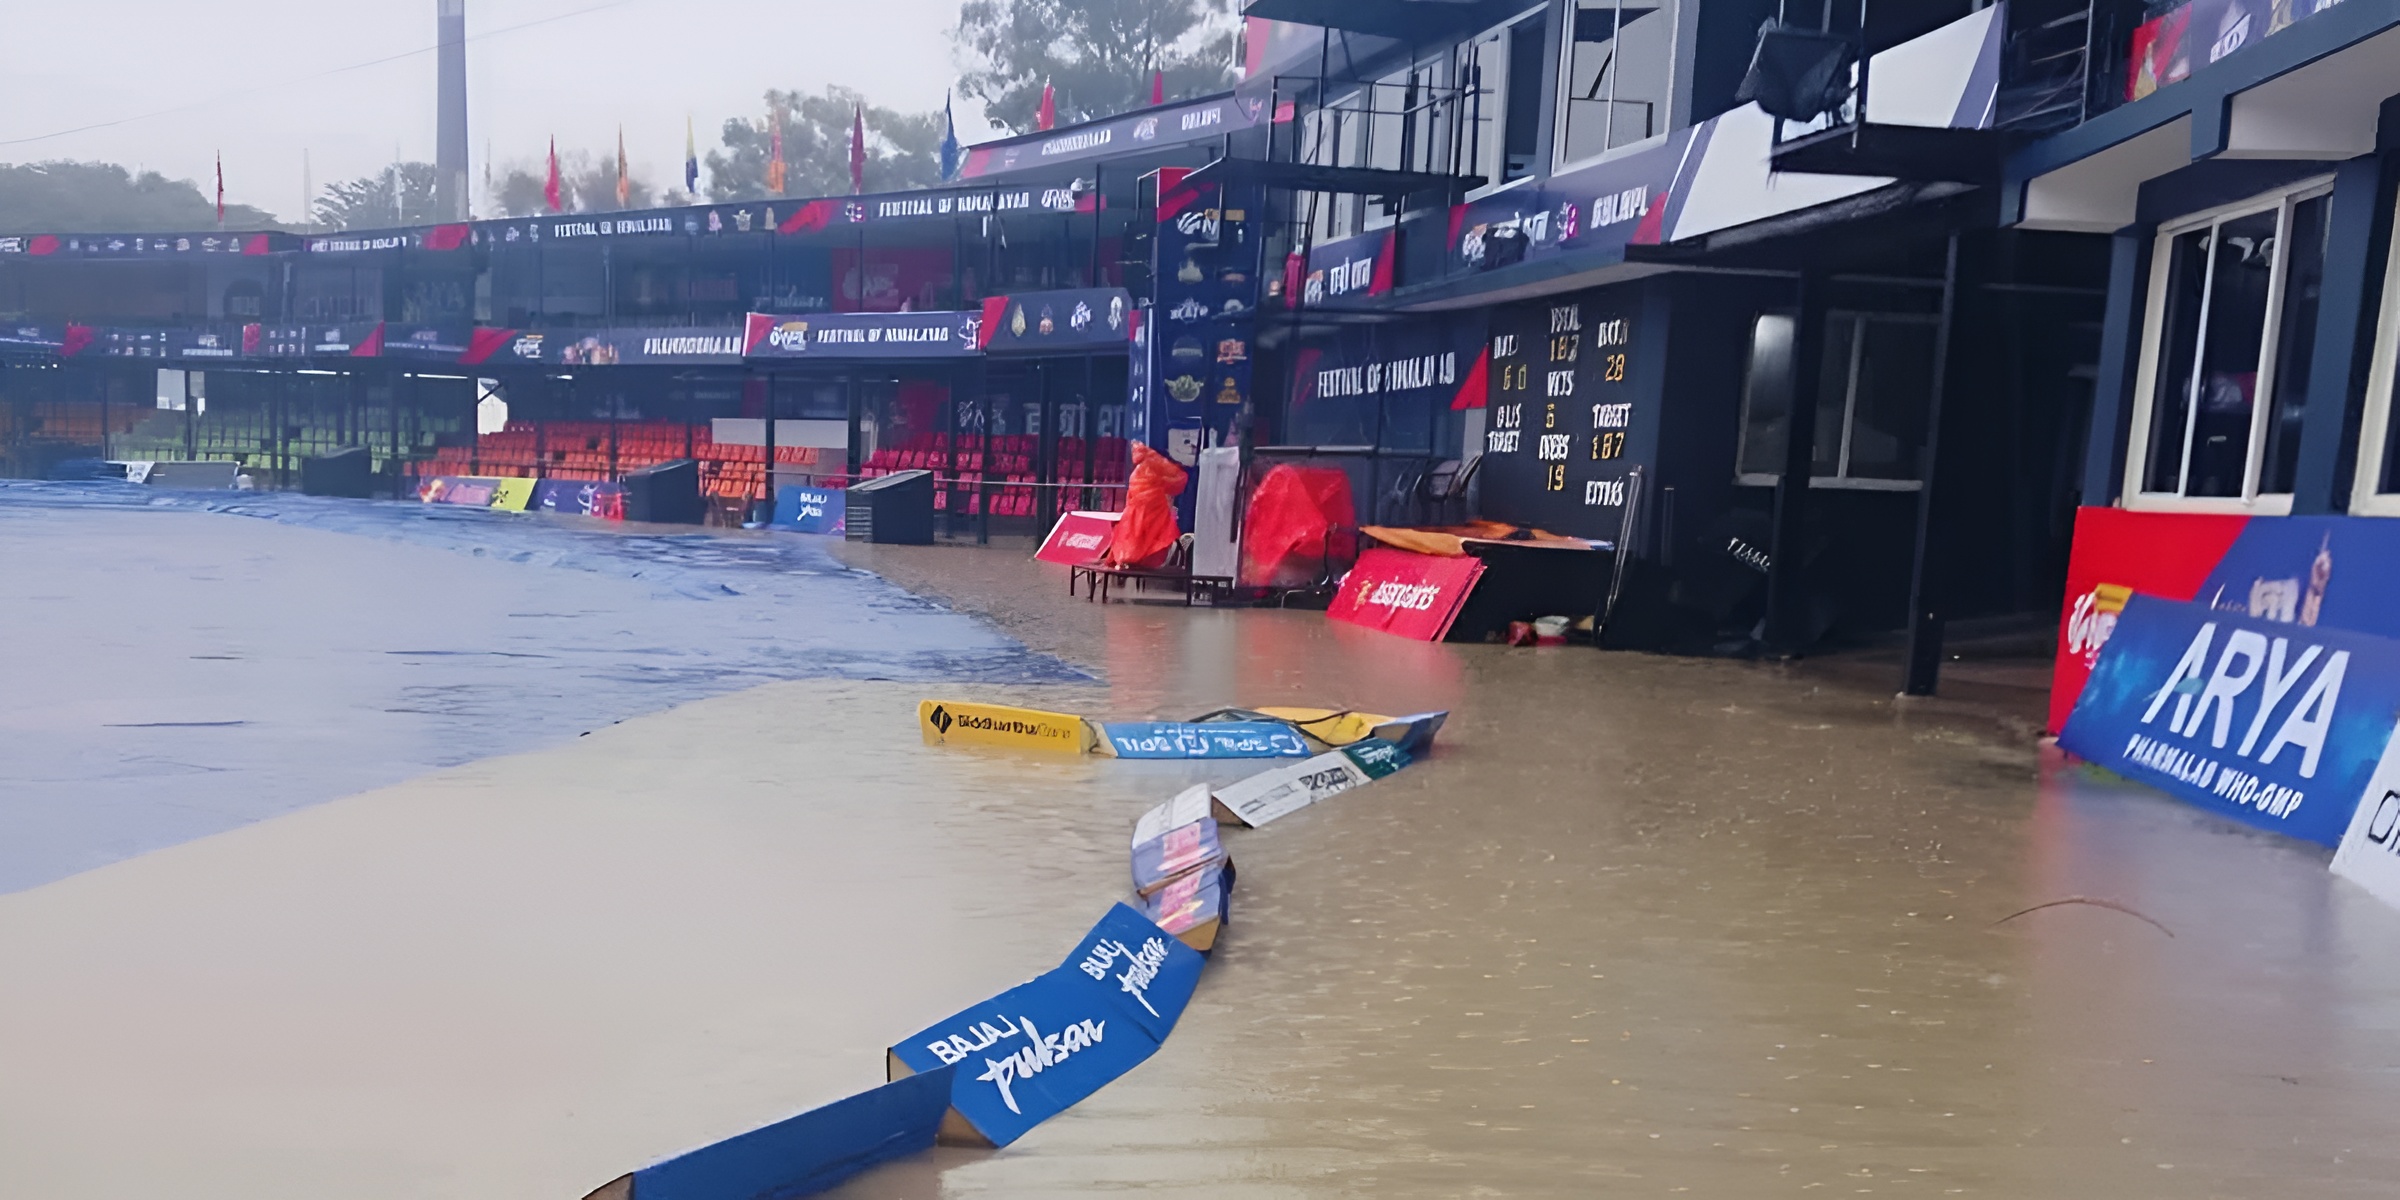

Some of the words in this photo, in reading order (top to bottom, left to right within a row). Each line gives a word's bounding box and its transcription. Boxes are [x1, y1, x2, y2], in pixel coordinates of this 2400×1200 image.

[2141, 622, 2351, 779] ARYA
[926, 1014, 1020, 1066] BAJAJ
[975, 1015, 1106, 1115] pulsar
